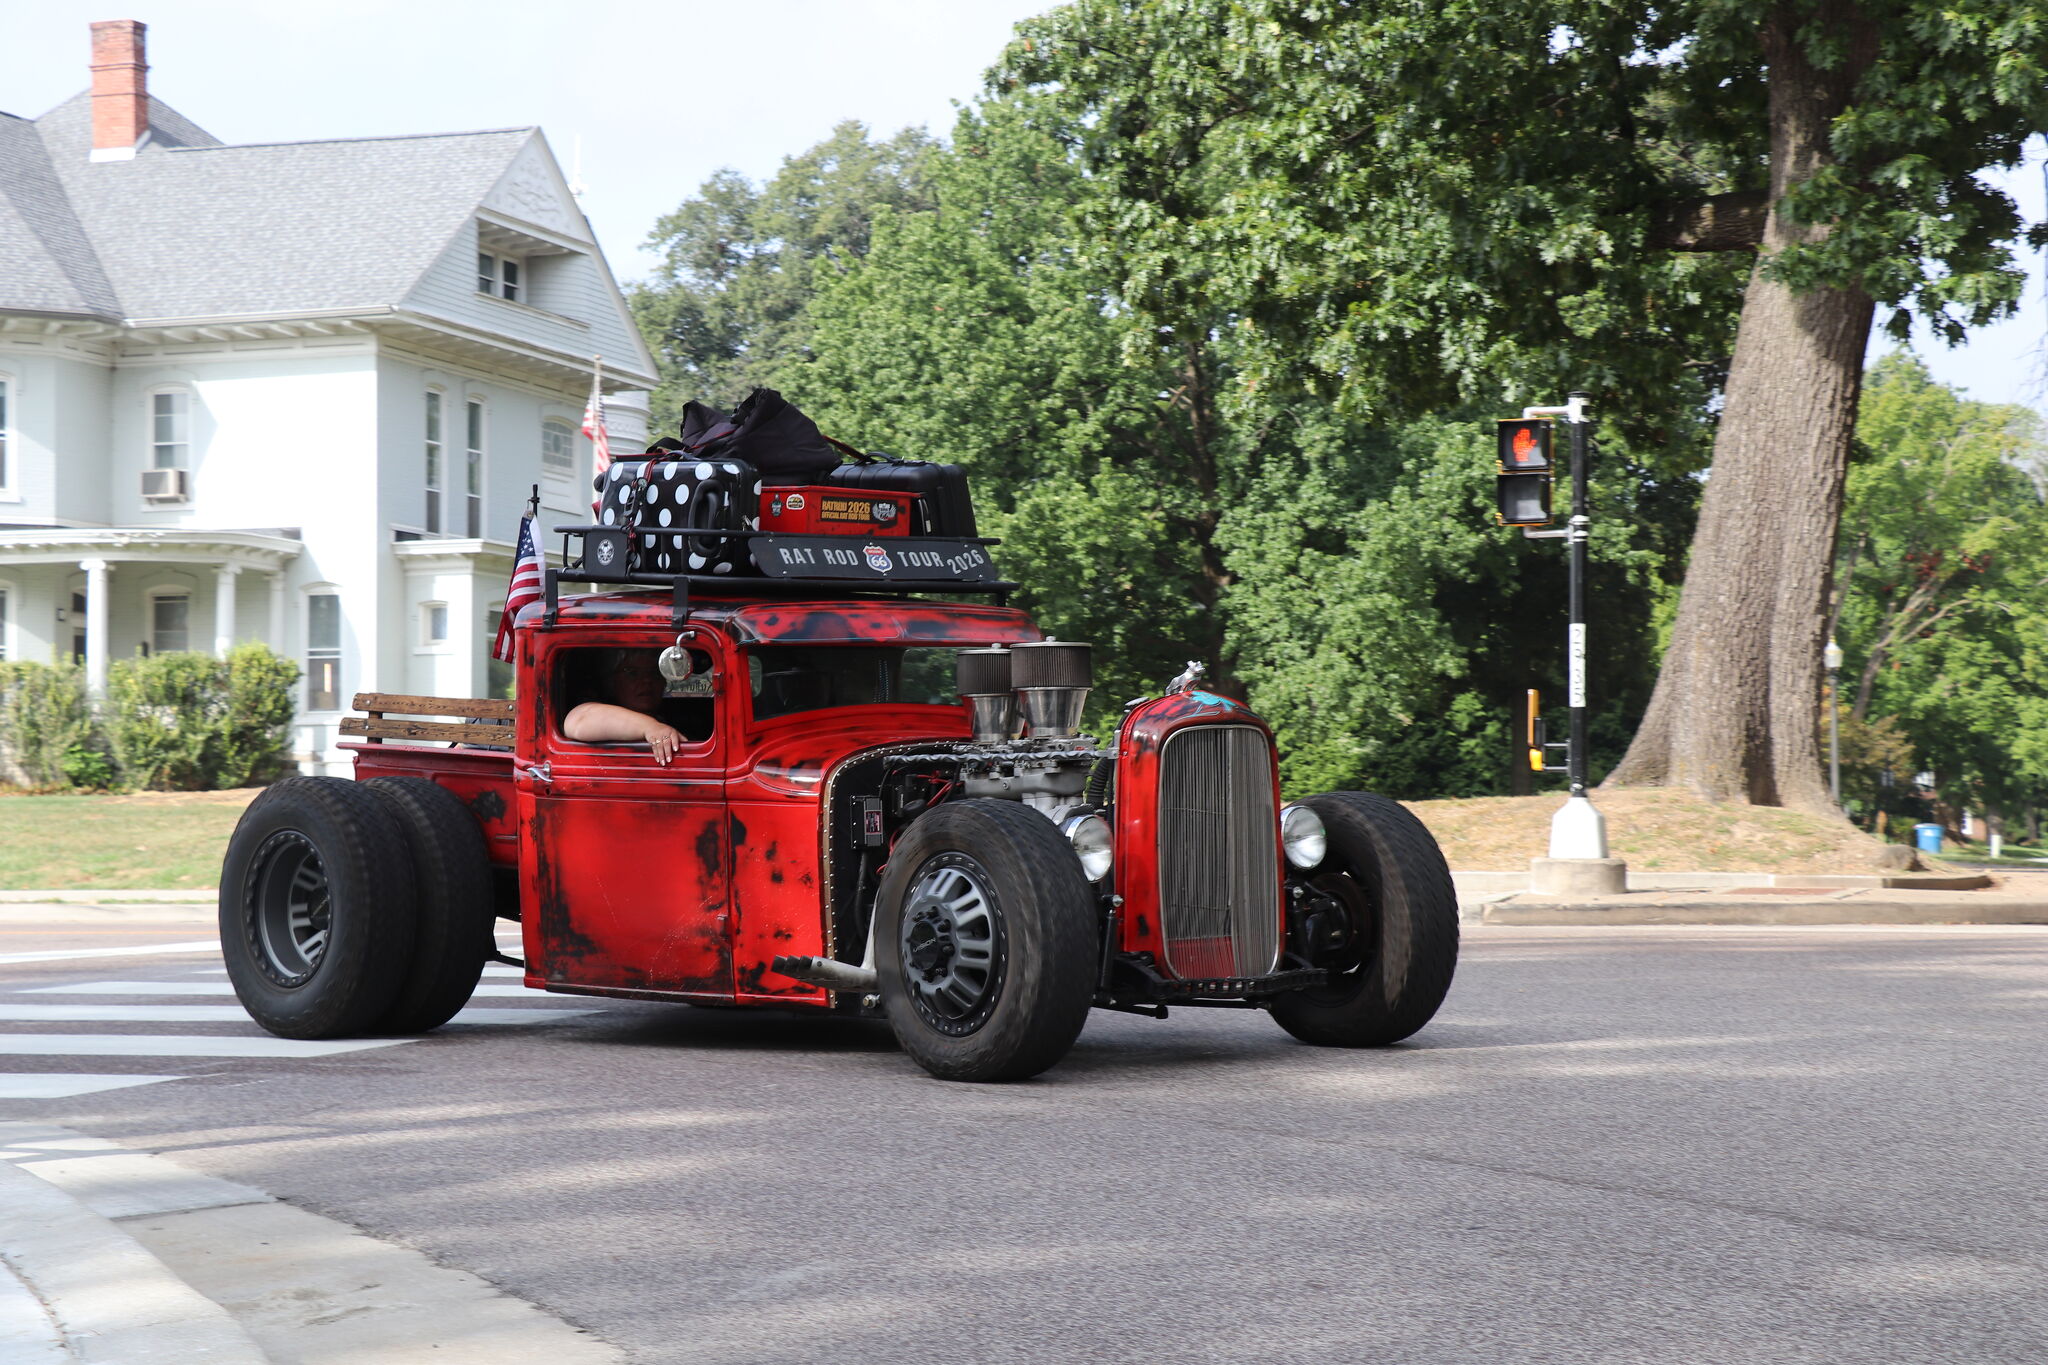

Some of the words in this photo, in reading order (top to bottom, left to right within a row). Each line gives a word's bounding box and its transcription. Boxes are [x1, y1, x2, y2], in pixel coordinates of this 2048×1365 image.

[848, 501, 870, 514] 2026
[779, 548, 816, 564] RAT
[822, 548, 859, 566] ROD
[896, 551, 945, 567] TOUR
[946, 549, 985, 575] 2026
[871, 556, 888, 567] 66
